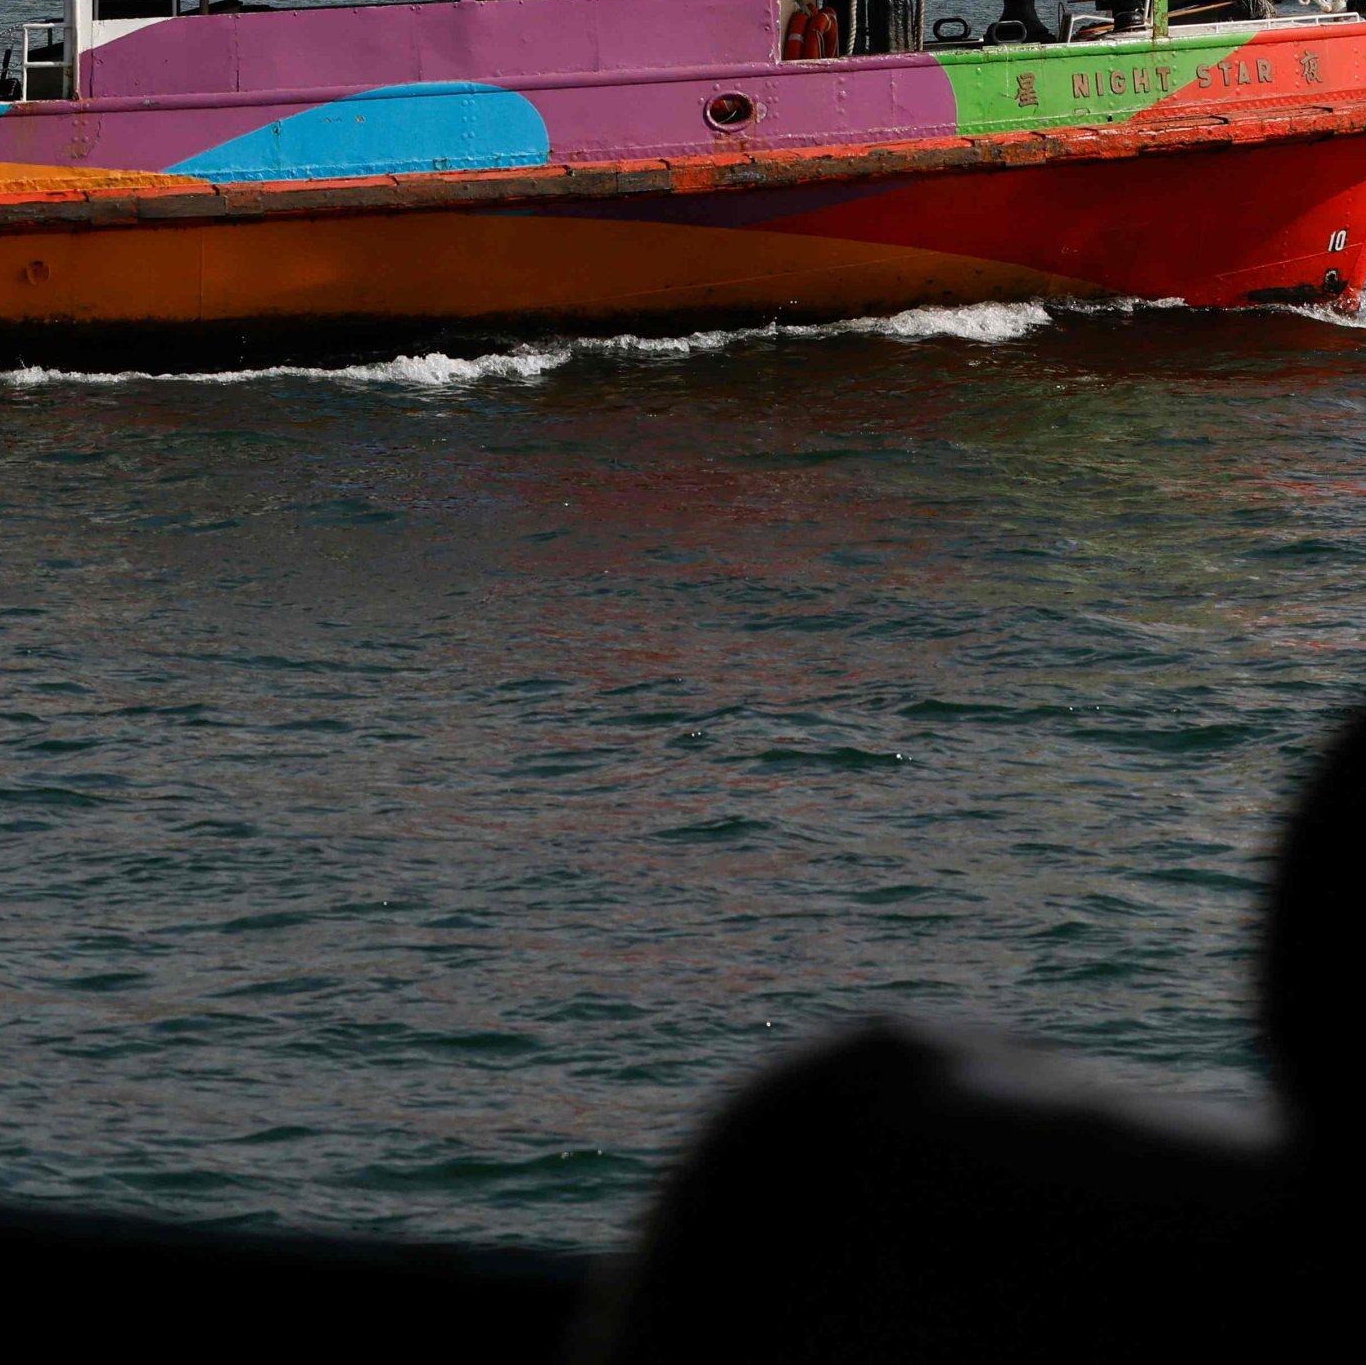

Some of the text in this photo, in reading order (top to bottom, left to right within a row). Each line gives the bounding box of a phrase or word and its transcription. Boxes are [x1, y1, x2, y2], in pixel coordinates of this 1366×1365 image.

[1072, 58, 1273, 99] NIGHT STAR
[1300, 49, 1324, 85] 夜
[1015, 72, 1039, 108] 星
[1328, 229, 1347, 252] 10
